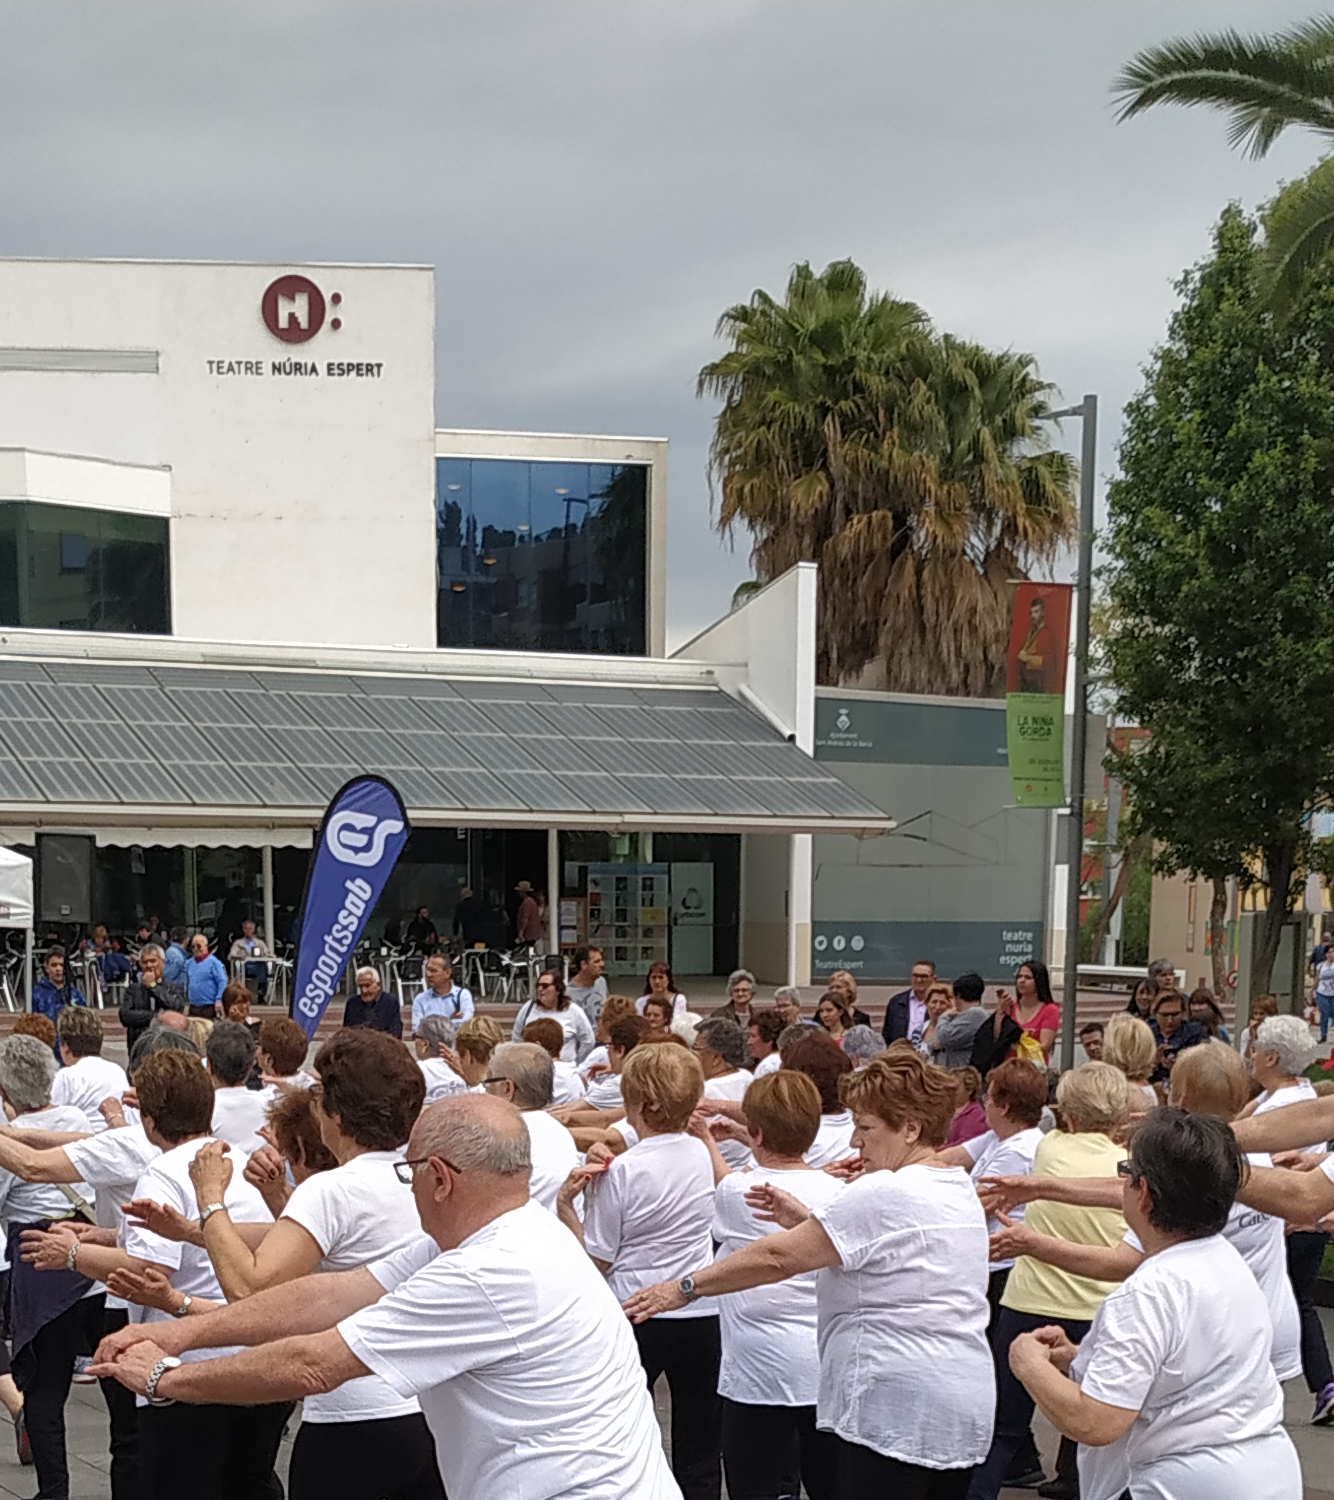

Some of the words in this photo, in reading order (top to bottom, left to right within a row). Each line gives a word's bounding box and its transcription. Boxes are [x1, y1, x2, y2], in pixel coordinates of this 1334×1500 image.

[206, 359, 264, 376] TEATRE
[271, 356, 319, 377] NÚRIA
[326, 361, 384, 378] ESPERT
[1002, 930, 1033, 941] teatre
[298, 877, 372, 1018] esportssab
